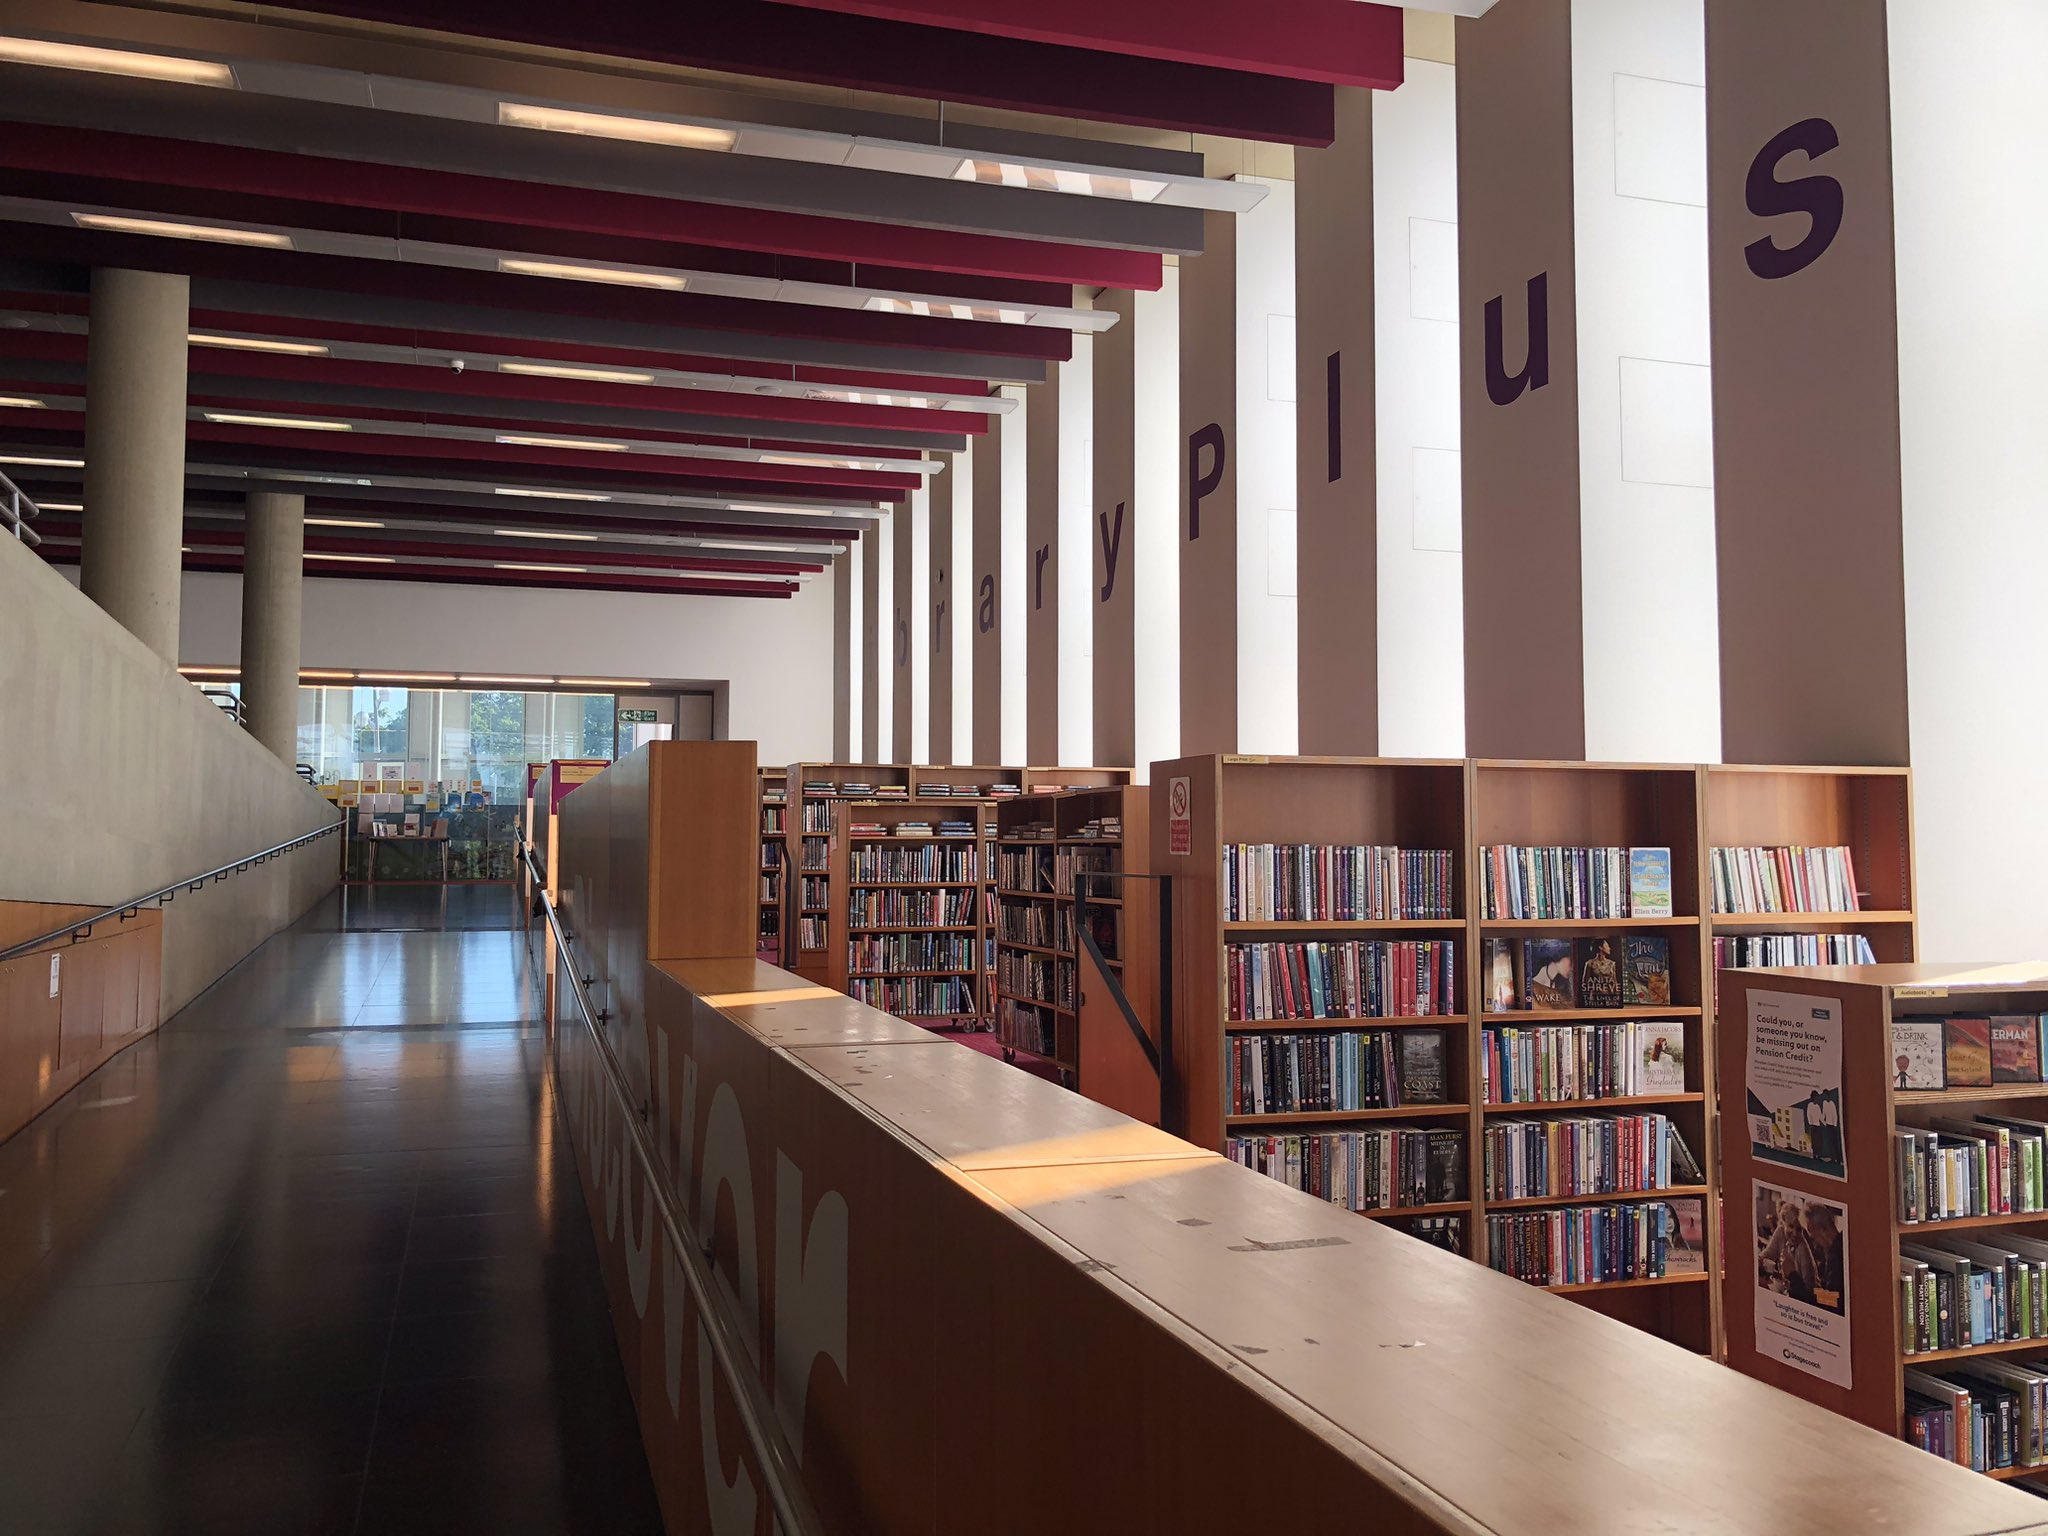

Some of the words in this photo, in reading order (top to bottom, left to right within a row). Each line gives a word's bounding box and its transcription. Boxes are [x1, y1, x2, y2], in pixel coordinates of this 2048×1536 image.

[1629, 941, 1654, 958] The
[1581, 983, 1621, 992] SHREVE
[1535, 994, 1561, 1002] WAKE
[1756, 1014, 1777, 1024] Could
[1779, 1019, 1795, 1028] you,
[1756, 1026, 1788, 1037] someone
[1805, 1032, 1827, 1043] know,
[1904, 1032, 1928, 1041] DRINK
[1766, 1038, 1795, 1050] missing
[1755, 1046, 1784, 1058] Pension
[1786, 1052, 1813, 1063] Credit?
[1790, 1352, 1821, 1369] Stagecoach
